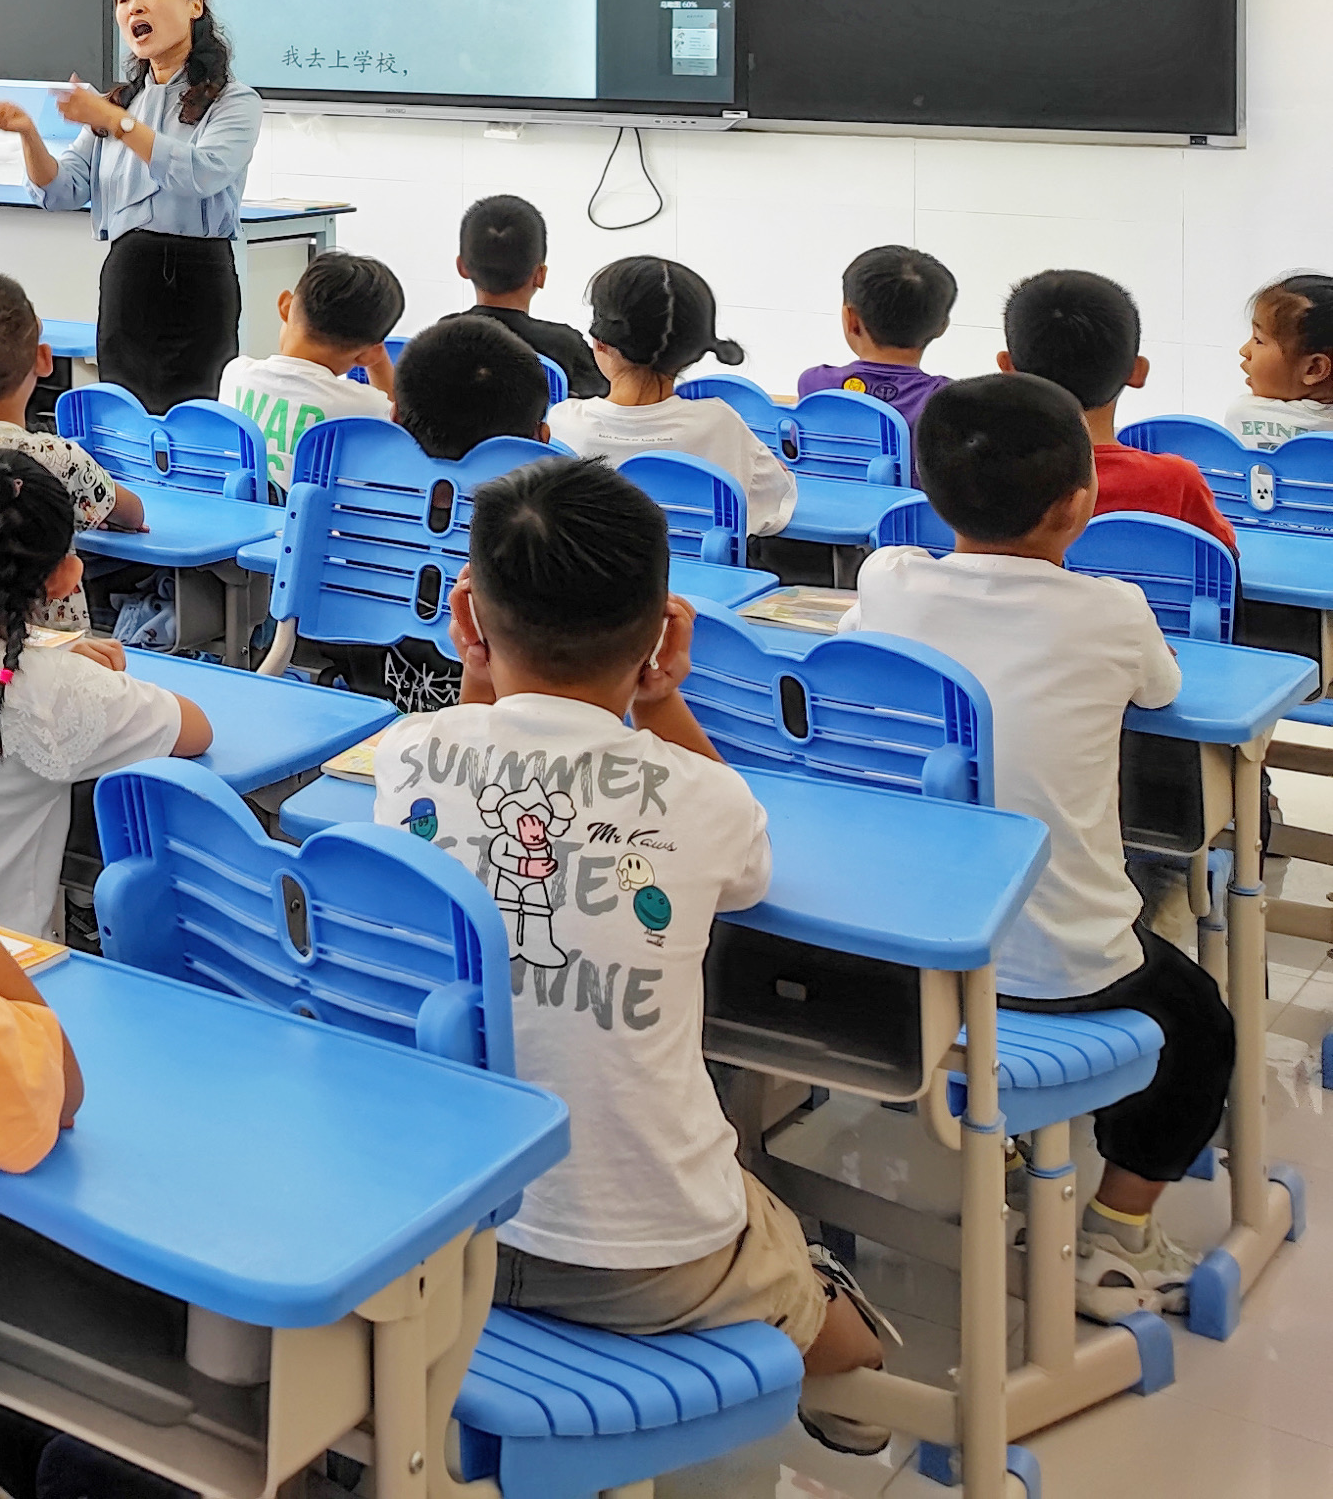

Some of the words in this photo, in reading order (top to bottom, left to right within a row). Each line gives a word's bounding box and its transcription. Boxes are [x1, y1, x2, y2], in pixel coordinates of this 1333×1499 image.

[281, 44, 410, 77] 我去上学校，
[586, 822, 623, 845] Mr
[626, 828, 678, 852] Kaws
